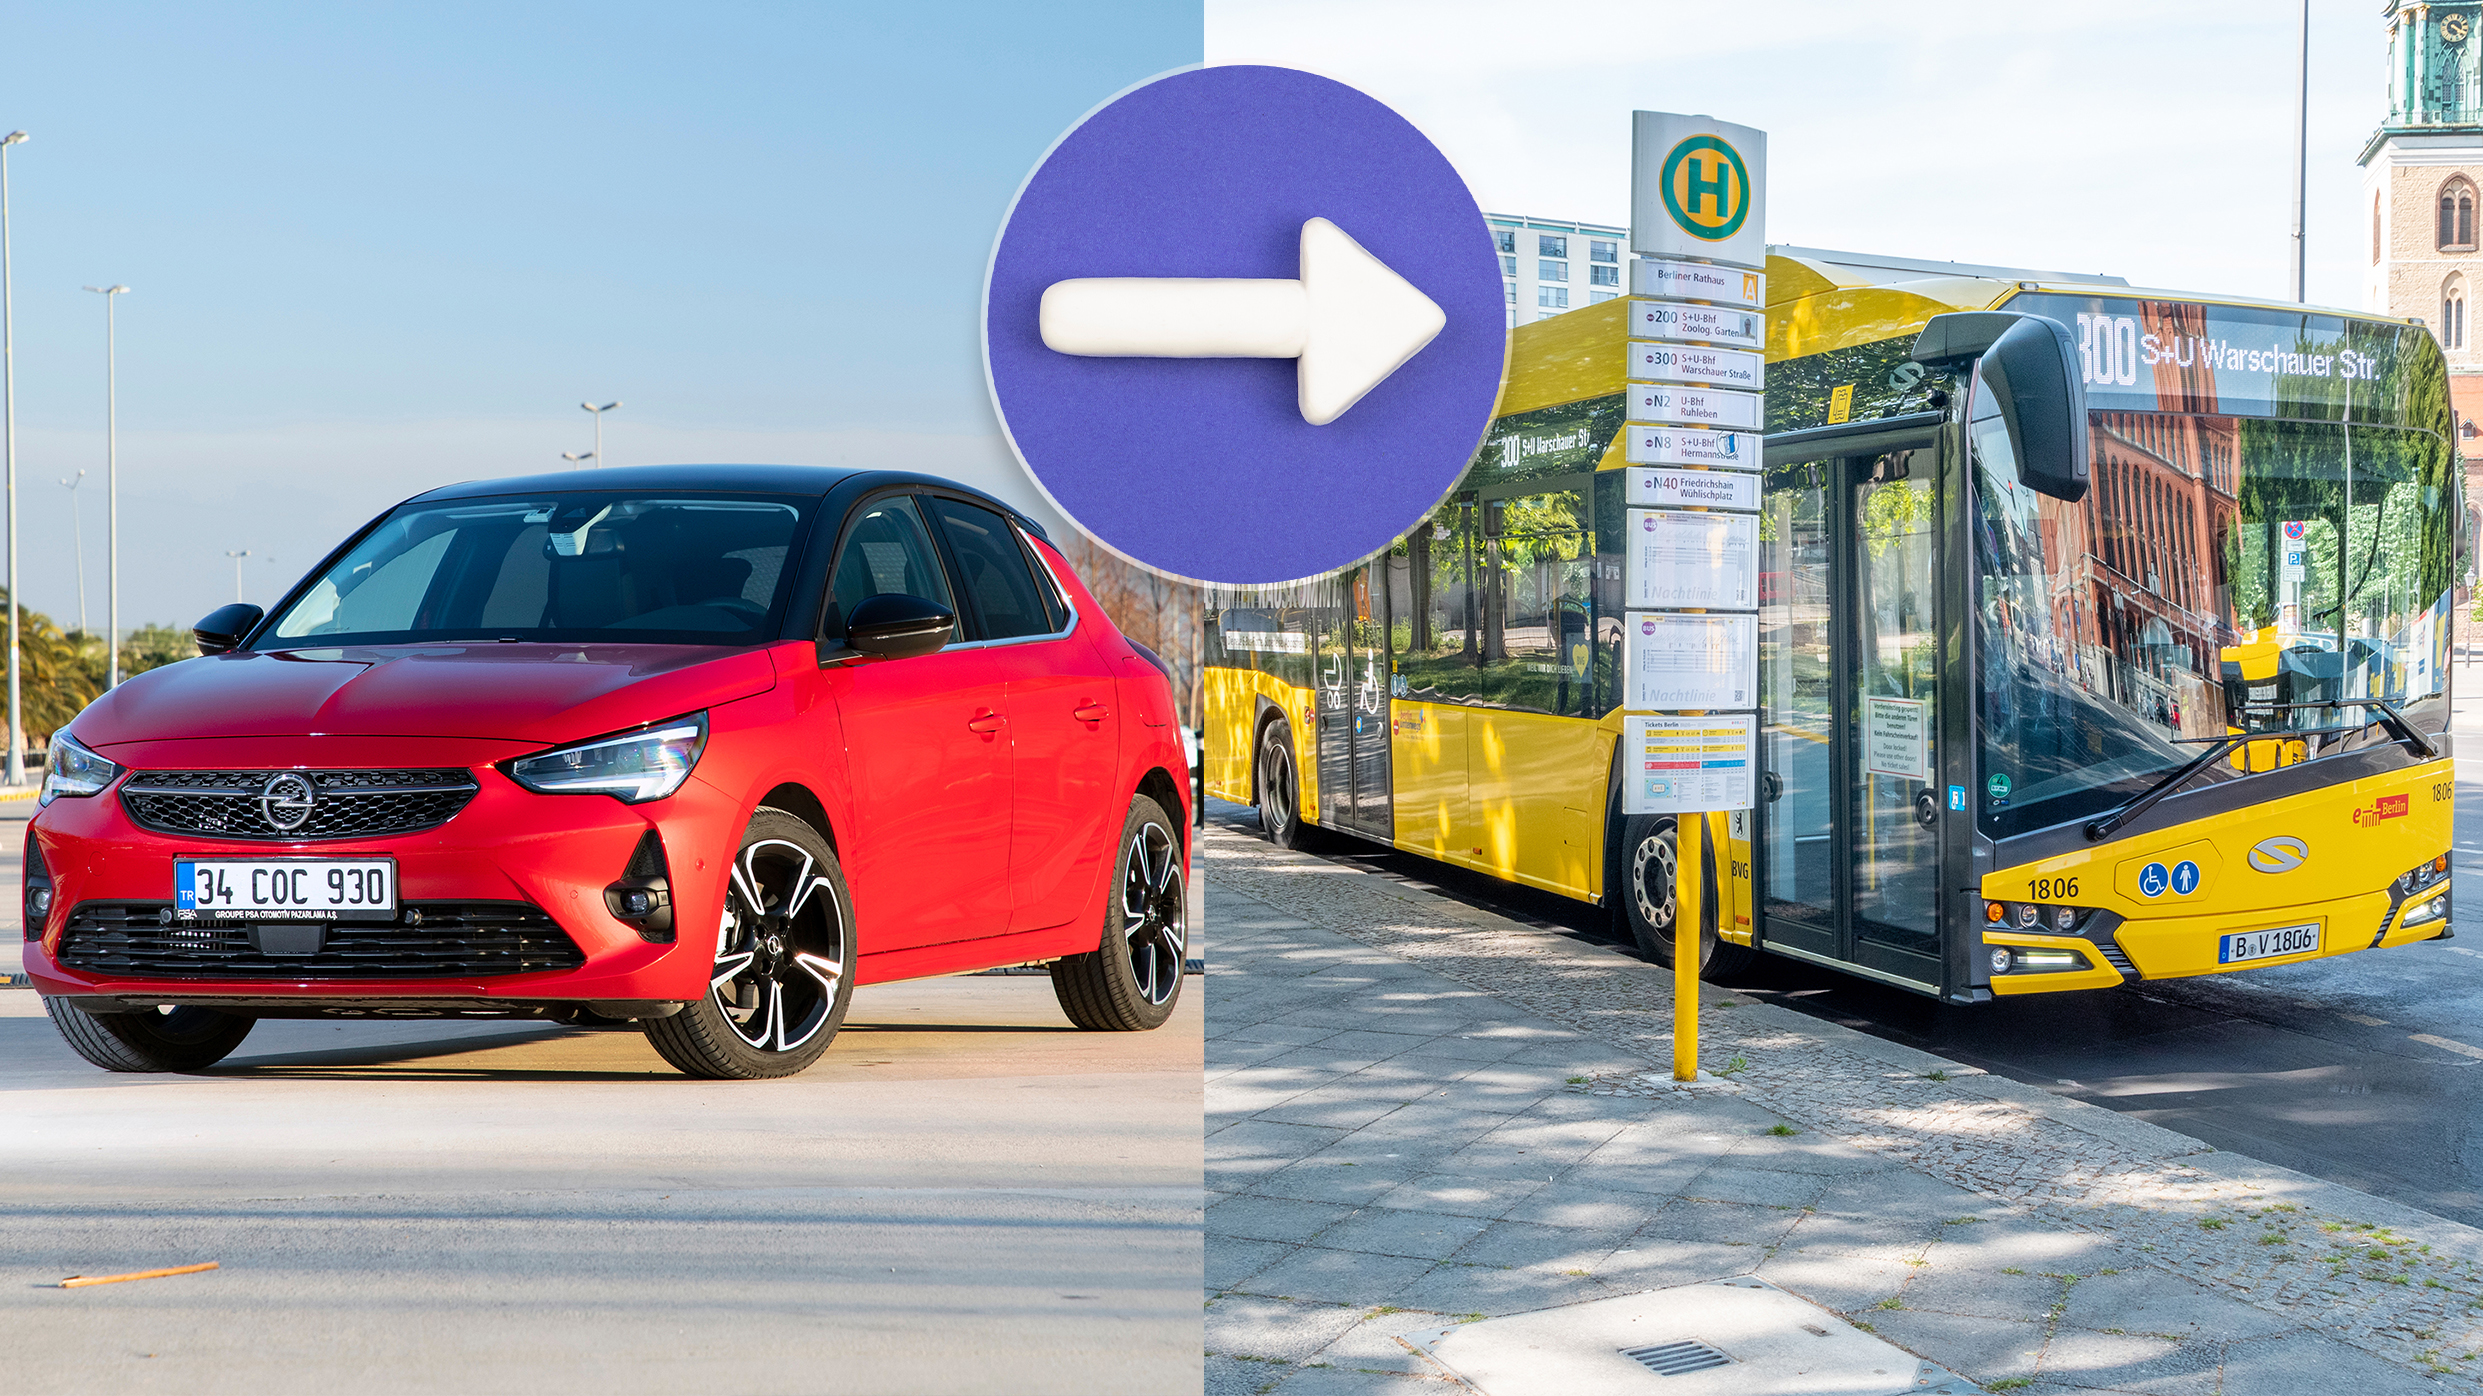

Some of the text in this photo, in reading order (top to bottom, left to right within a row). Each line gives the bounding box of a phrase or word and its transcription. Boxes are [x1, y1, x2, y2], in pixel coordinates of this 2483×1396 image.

[1688, 158, 1729, 218] H
[1658, 269, 1725, 285] Berliner Rathaus
[1745, 279, 1757, 302] A
[1655, 310, 1678, 324] 200
[1682, 312, 1717, 324] S+U-Bhf
[1682, 323, 1739, 338] Zoolog. Garten
[2077, 313, 2381, 386] 300 S+U Warschauer Str.
[1654, 352, 1678, 365] 300
[1682, 353, 1716, 365] S+U-Bhf
[1681, 365, 1751, 380] Warschauer Straße
[1654, 395, 1671, 407] N2
[1681, 396, 1704, 407] U-Bhf
[1681, 407, 1718, 419] Ruhleben
[1654, 436, 1672, 449] N8
[1681, 437, 1715, 448] S+U-Bhf
[1501, 434, 1519, 468] 300
[1522, 436, 1536, 457] S+U
[1537, 432, 1577, 454] Warschauer
[1653, 476, 1678, 489] N40
[1680, 478, 1734, 490] Friedrichshain
[1680, 488, 1733, 501] Wühlischplatz
[1651, 586, 1717, 600] Nachtlinie
[1649, 688, 1716, 702] Nachtlinie
[1997, 775, 2003, 786] 4
[2432, 781, 2452, 802] 1806
[2382, 800, 2406, 815] Berlin
[1732, 860, 1748, 880] BVG
[197, 868, 383, 904] 34 COC 930
[2028, 877, 2079, 900] 1806
[180, 890, 194, 901] TR
[178, 909, 197, 917] PSA
[2236, 928, 2311, 958] B V 1806
